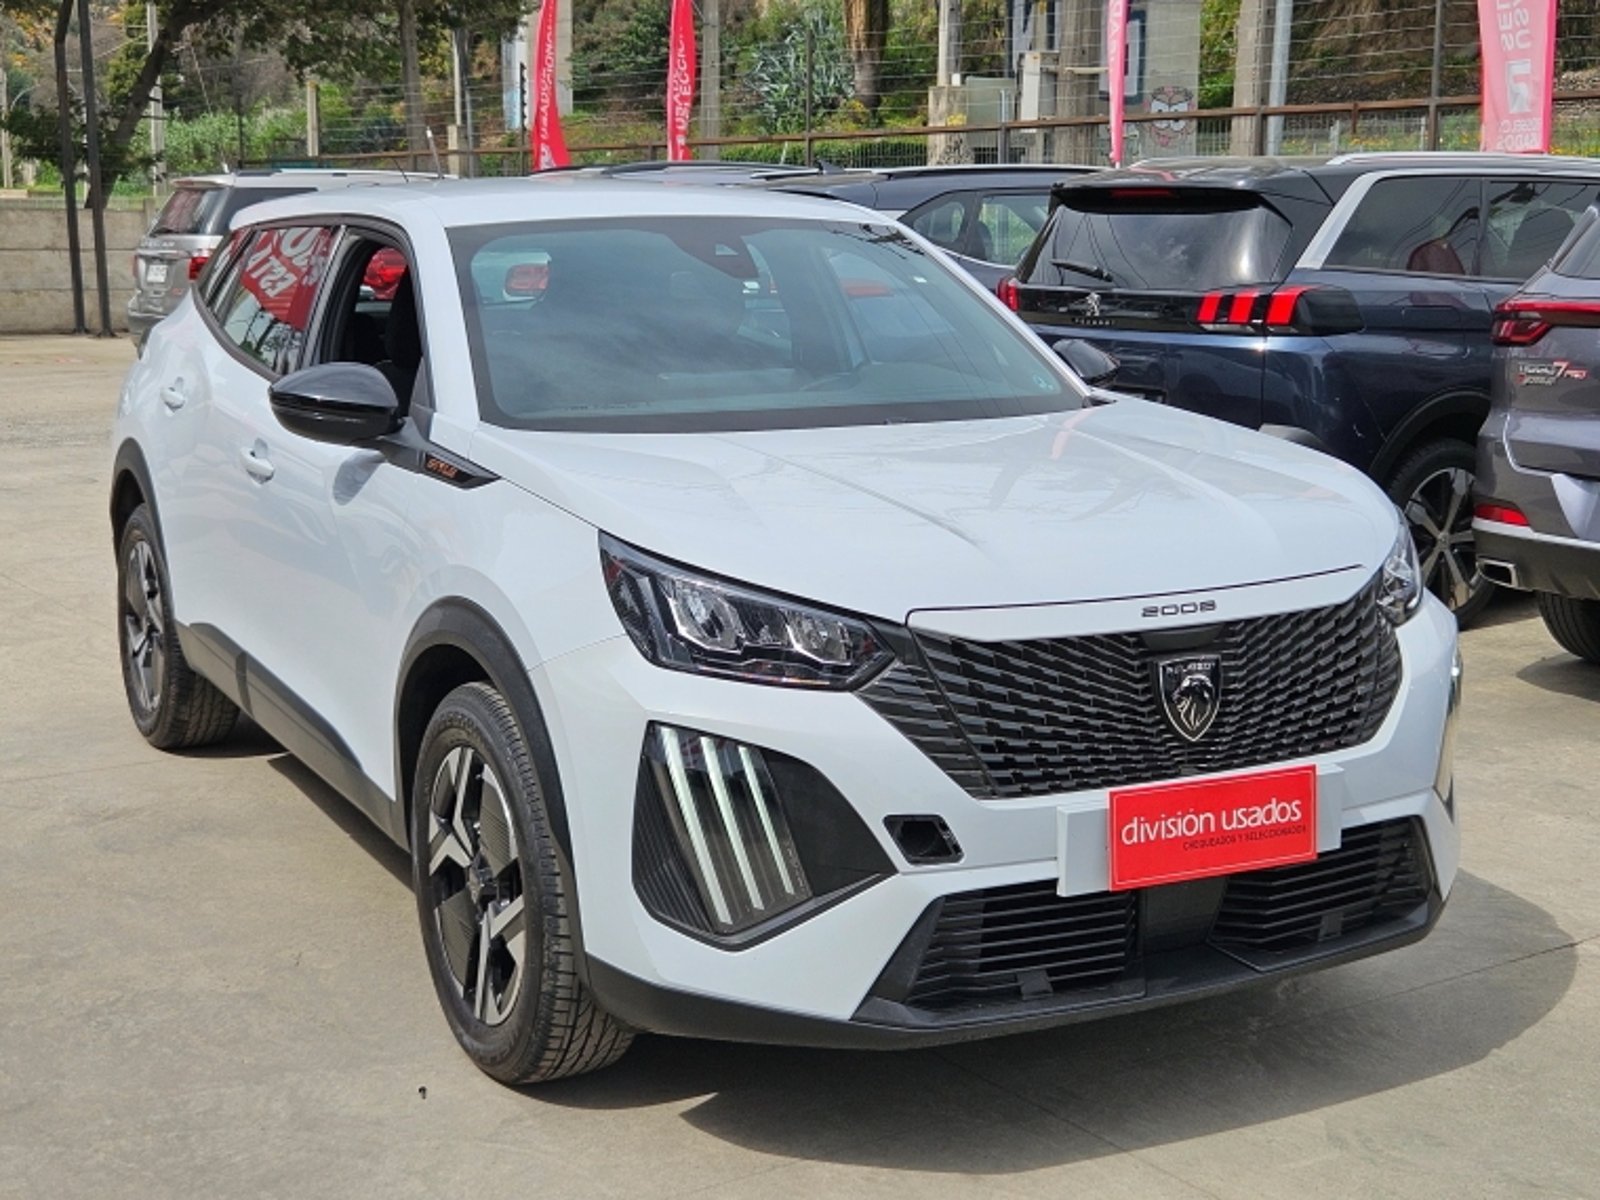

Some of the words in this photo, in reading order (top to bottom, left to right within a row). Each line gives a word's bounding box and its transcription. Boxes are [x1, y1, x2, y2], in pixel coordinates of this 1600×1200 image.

[1142, 600, 1216, 618] 2008
[1121, 807, 1215, 846] división
[1221, 797, 1302, 831] usados
